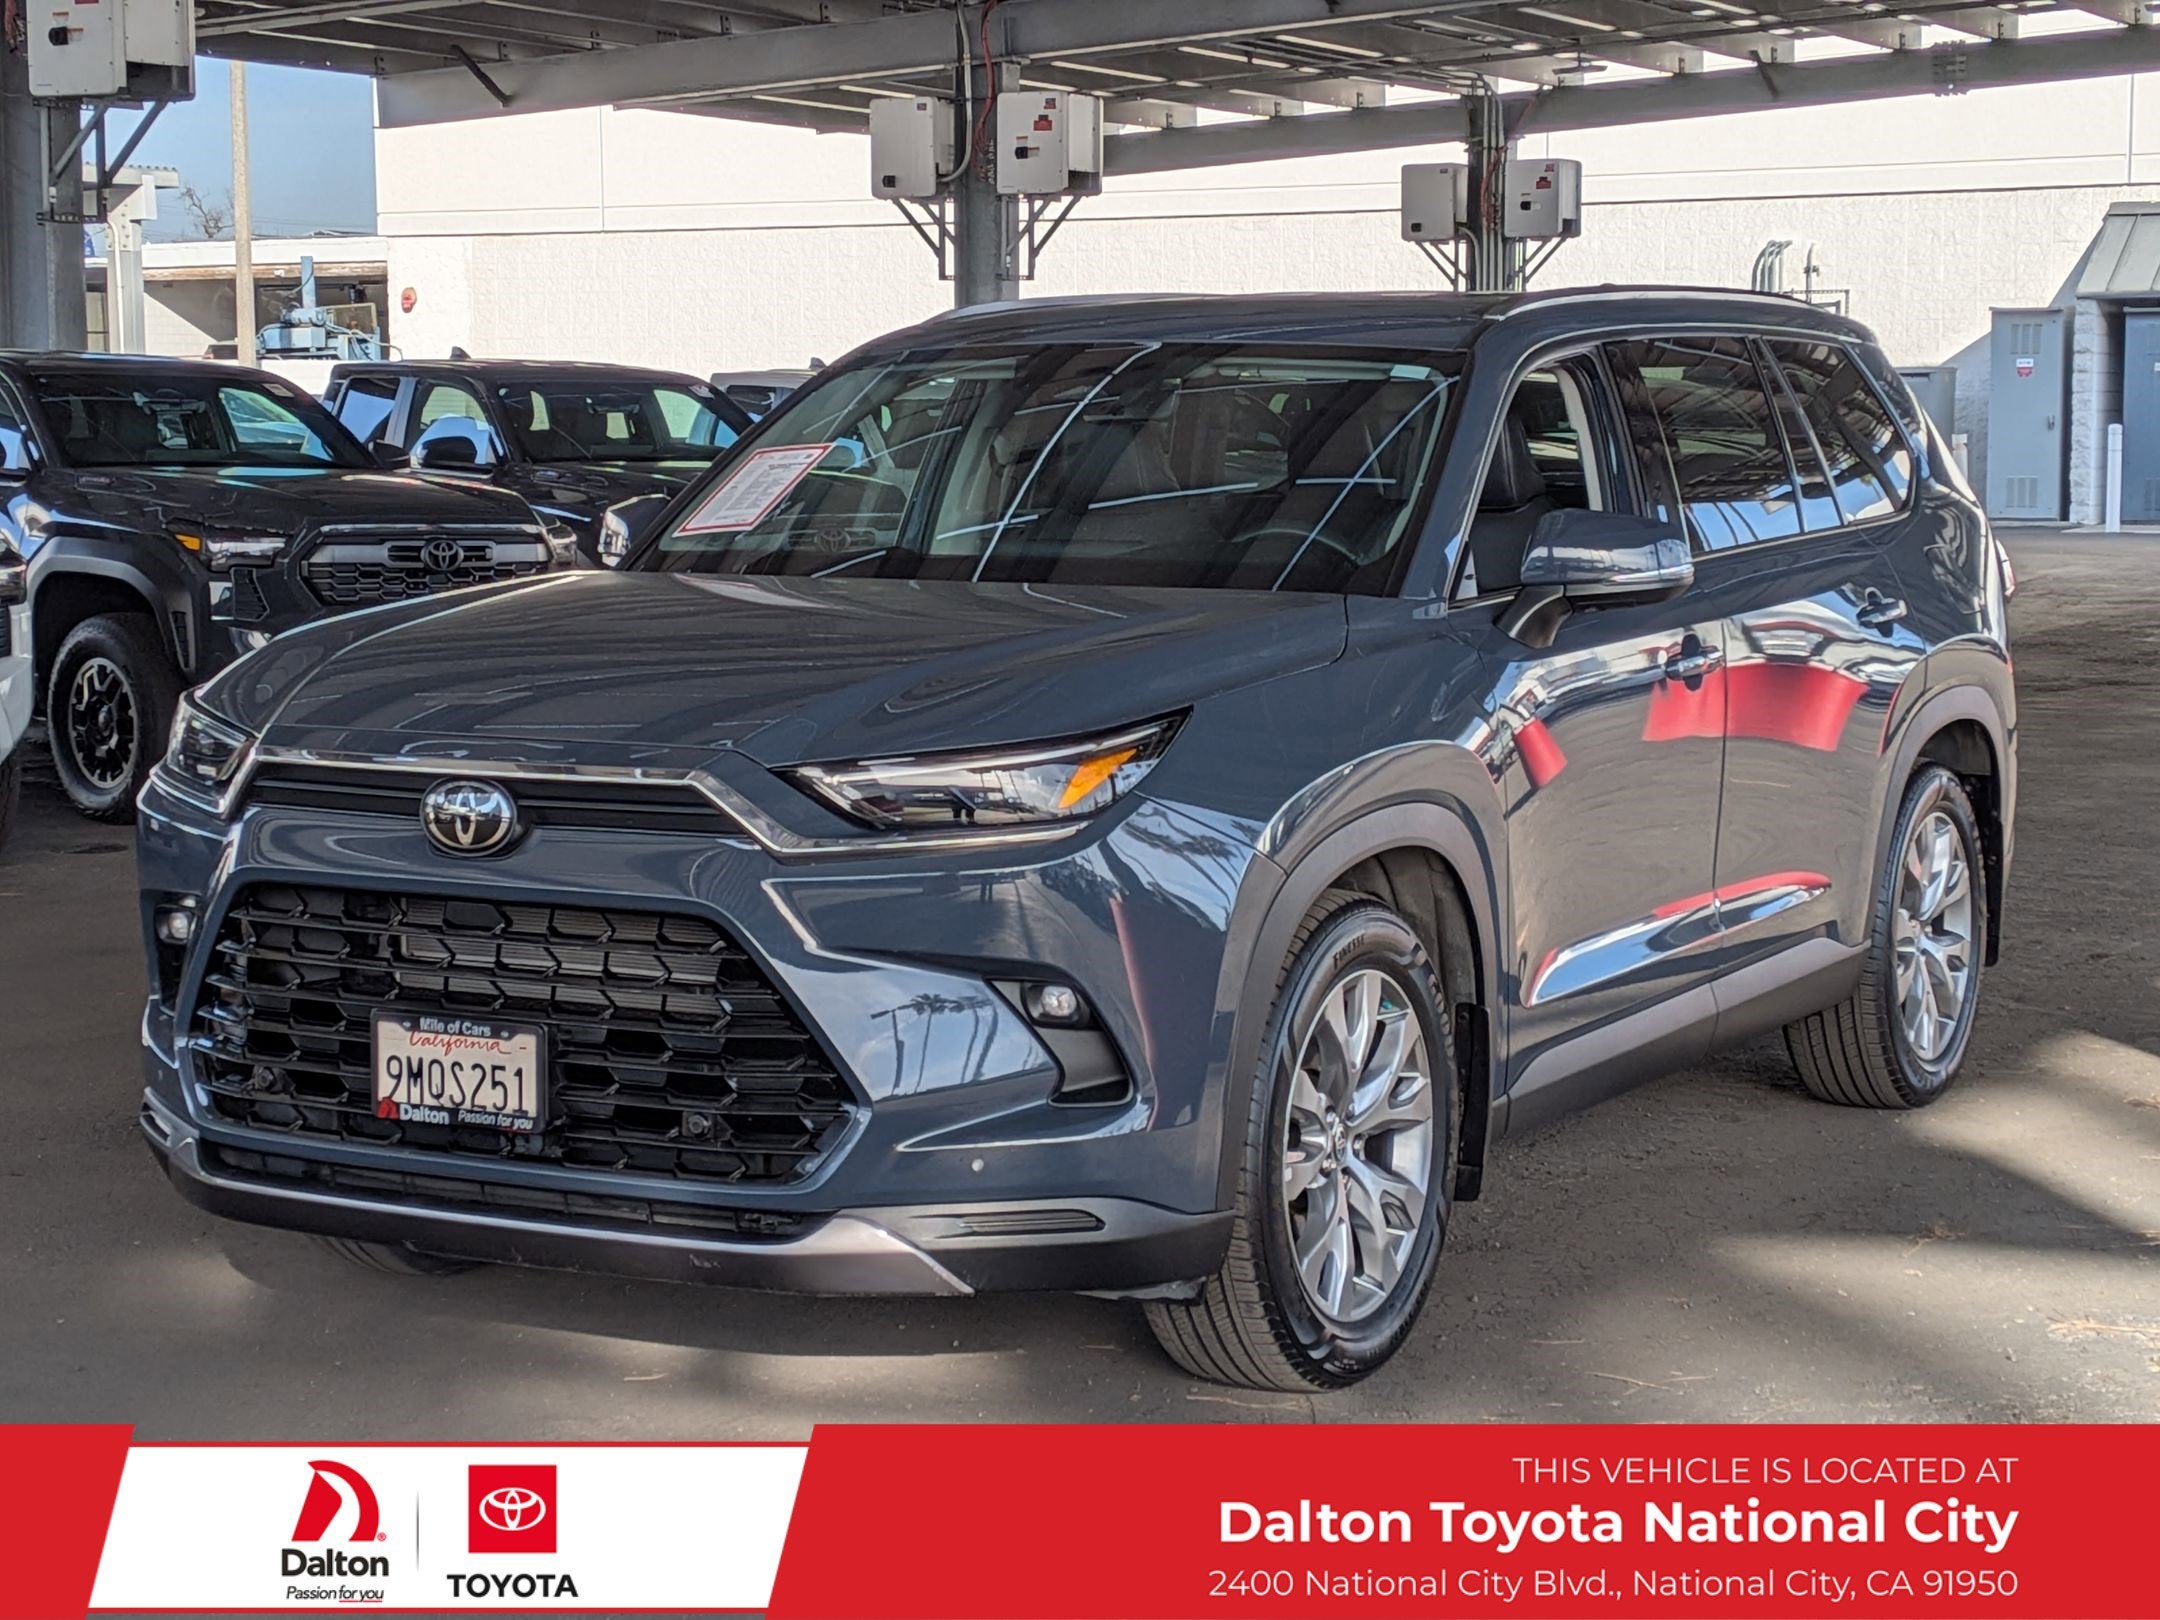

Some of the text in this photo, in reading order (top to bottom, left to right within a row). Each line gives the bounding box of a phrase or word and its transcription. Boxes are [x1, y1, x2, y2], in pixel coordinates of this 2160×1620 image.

[419, 1017, 492, 1037] Mile of Cars
[409, 1031, 512, 1056] California
[386, 1054, 529, 1116] 9MQS251
[400, 1104, 534, 1130] Dalton Passion for you
